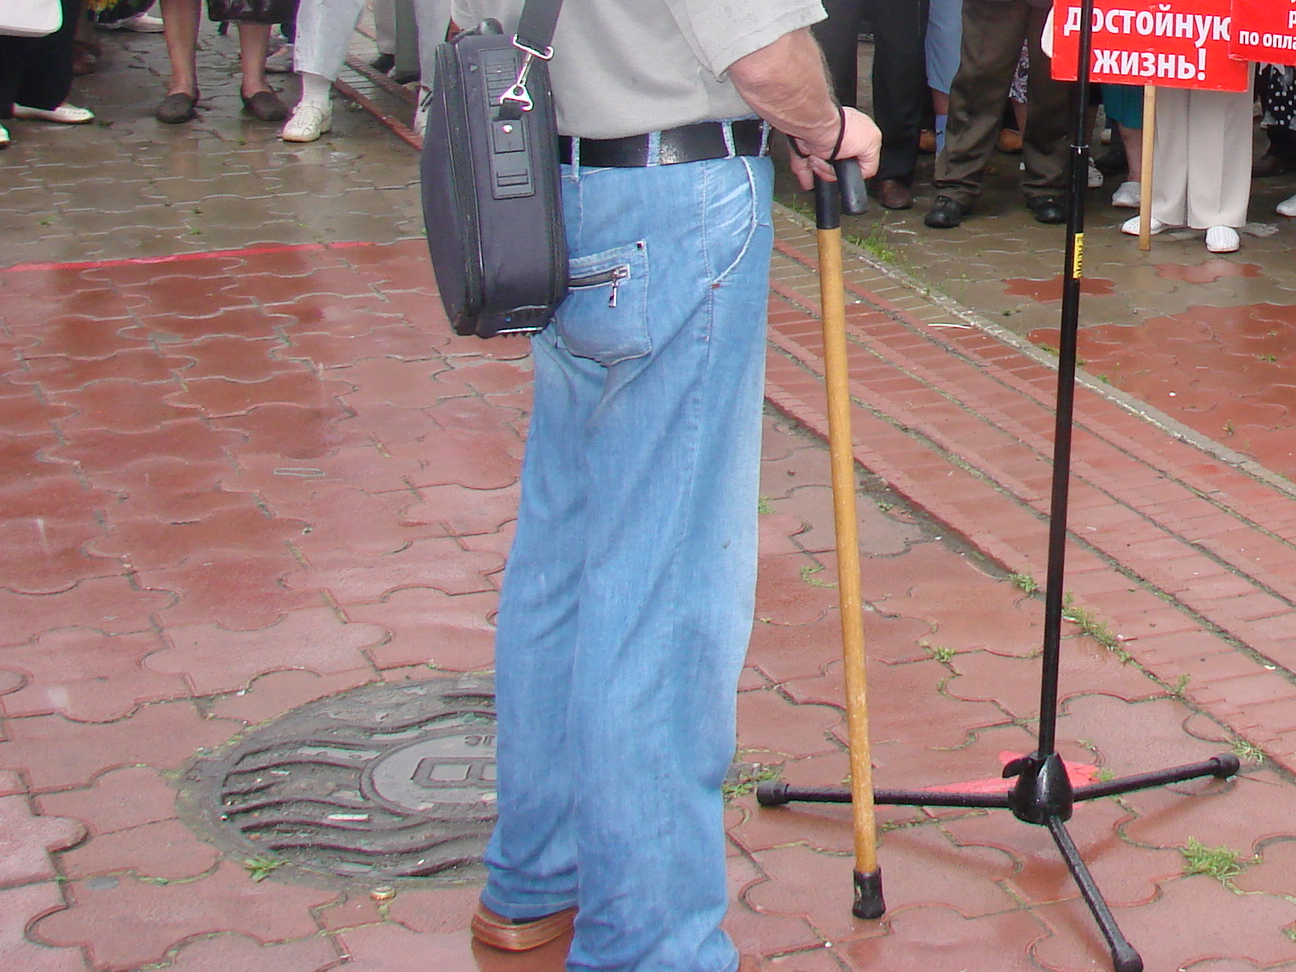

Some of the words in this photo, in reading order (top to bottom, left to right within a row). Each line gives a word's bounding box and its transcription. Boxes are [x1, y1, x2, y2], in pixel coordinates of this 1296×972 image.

[1063, 3, 1231, 49] достойную
[1239, 30, 1260, 46] по
[1092, 48, 1207, 81] жизнь!
